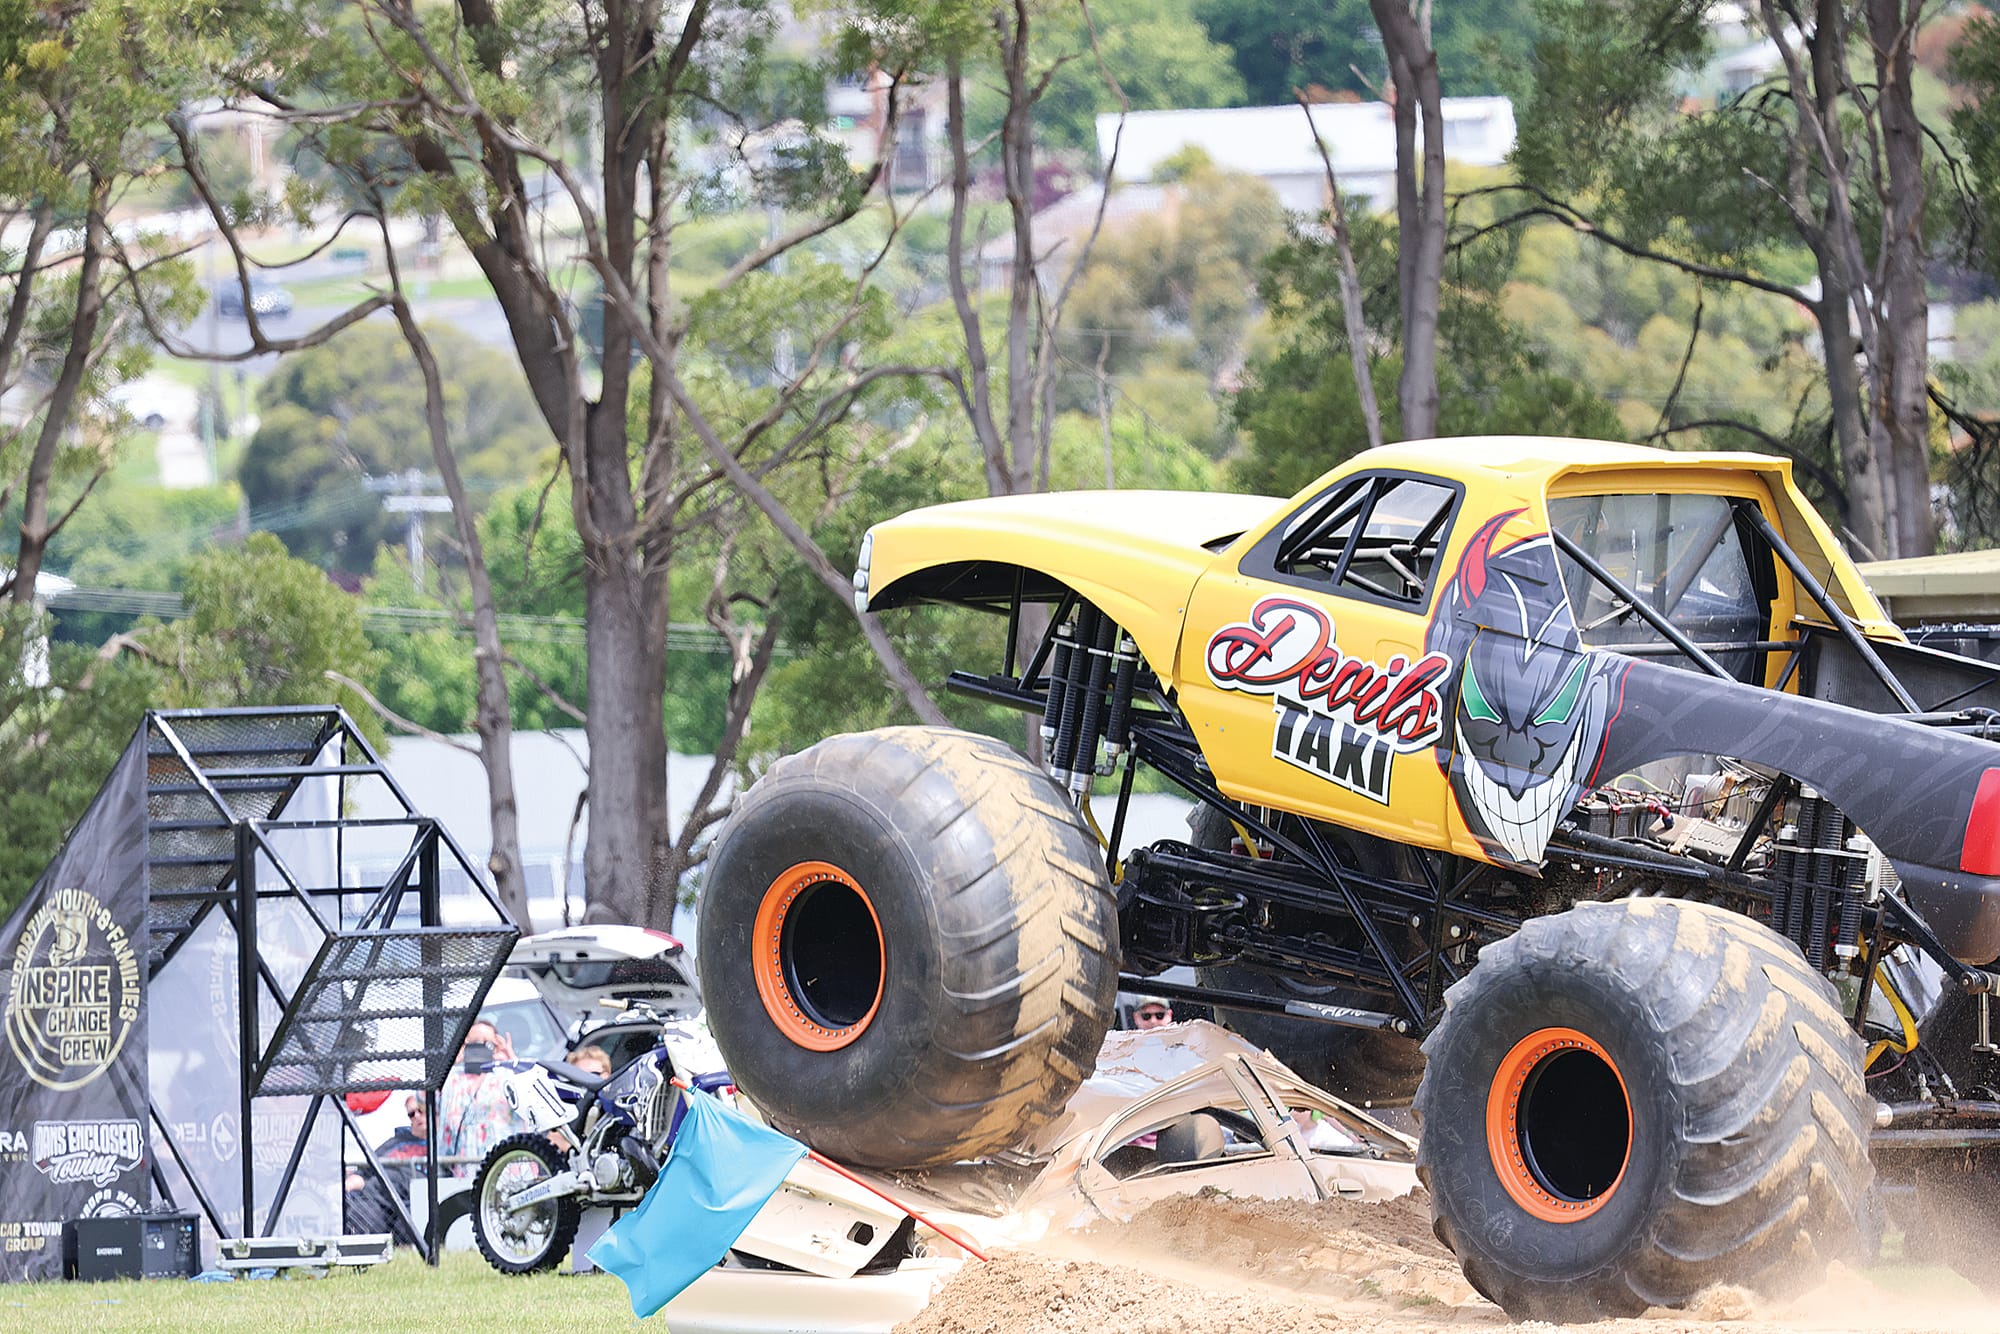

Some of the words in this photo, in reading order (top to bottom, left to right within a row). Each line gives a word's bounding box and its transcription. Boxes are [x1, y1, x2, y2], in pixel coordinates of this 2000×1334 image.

[1207, 598, 1448, 743] Devils
[1274, 695, 1390, 797] TAXI
[55, 888, 99, 920] YOUTH
[106, 925, 140, 1023] FAMILIES
[20, 968, 110, 1007] INSPIRE
[49, 1009, 109, 1032] CHANGE
[63, 1039, 108, 1061] CREW
[0, 1131, 28, 1152] RA
[68, 1123, 138, 1160] ENCLOSED
[49, 1150, 117, 1183] Towing
[0, 1222, 21, 1236] CAR
[6, 1237, 45, 1252] GROUP
